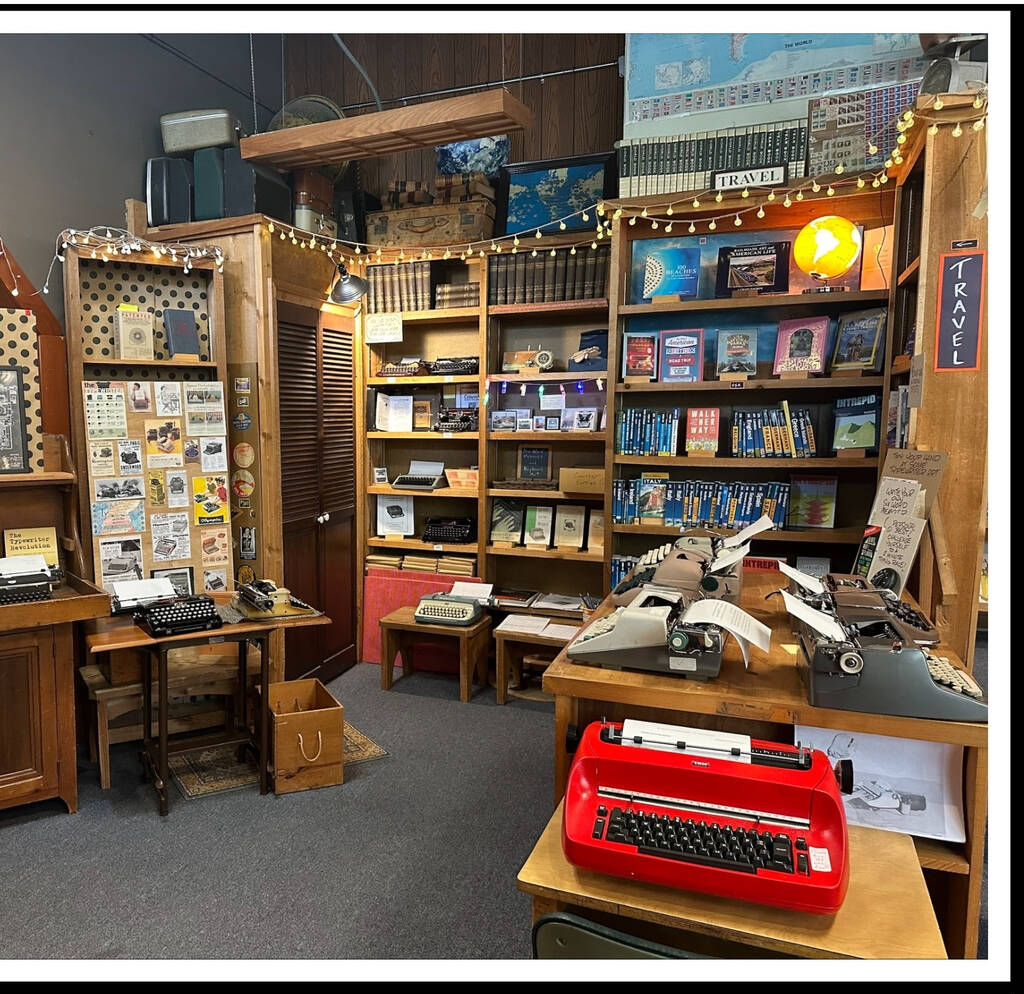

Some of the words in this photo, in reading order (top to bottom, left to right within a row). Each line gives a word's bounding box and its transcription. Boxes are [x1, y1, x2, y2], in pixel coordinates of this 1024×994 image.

[718, 171, 779, 187] TRAVEL
[949, 257, 974, 367] TRAVEL
[836, 394, 876, 408] INTREPID
[691, 410, 715, 418] WALK
[764, 427, 772, 449] FRANCE
[10, 537, 50, 545] Typewriter
